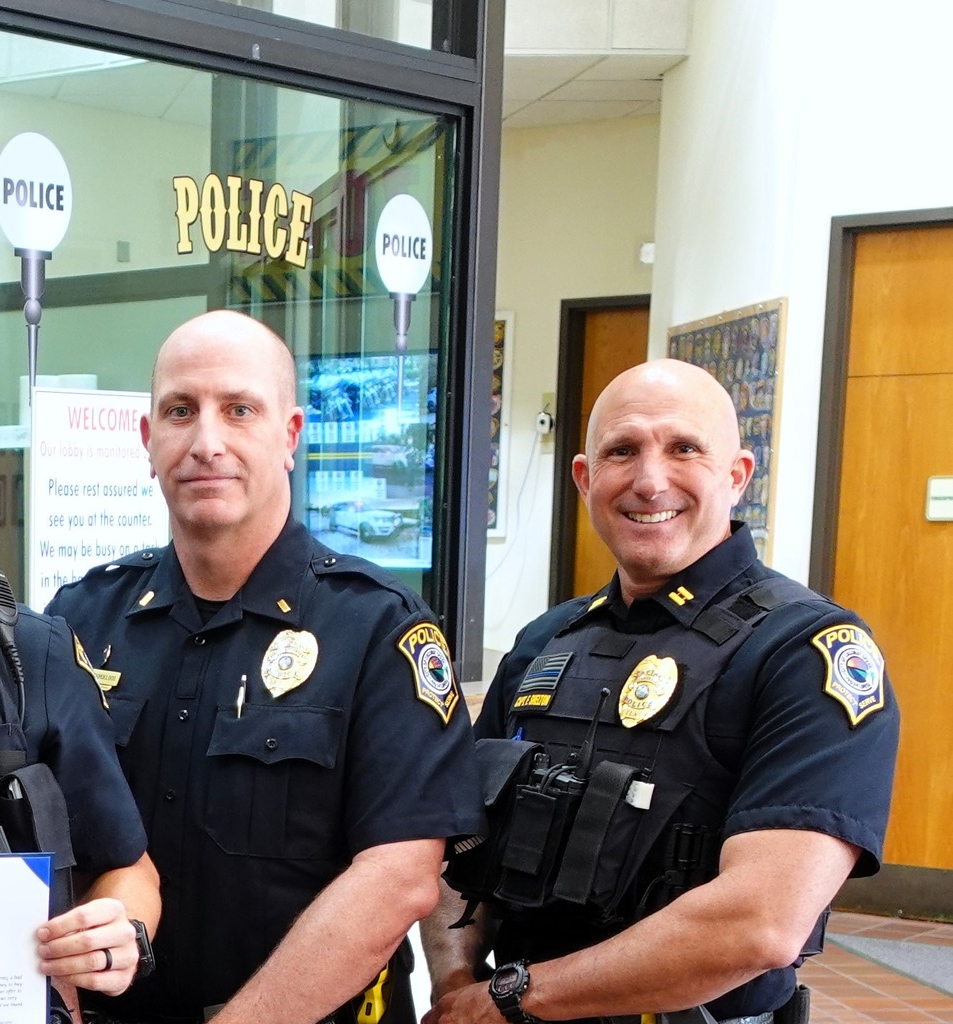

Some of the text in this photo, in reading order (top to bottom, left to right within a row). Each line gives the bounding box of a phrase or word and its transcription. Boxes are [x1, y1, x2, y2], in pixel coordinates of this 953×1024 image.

[3, 176, 65, 212] POLICE
[172, 172, 314, 270] POLICE
[381, 232, 427, 261] POLICE
[68, 405, 138, 432] WELCOME
[40, 440, 56, 457] Our
[60, 440, 84, 459] lobby
[87, 445, 94, 458] is
[96, 444, 141, 459] monitored
[48, 478, 154, 497] Please rest assured we
[48, 509, 153, 532] see you at the counter.
[40, 540, 56, 558] We
[58, 546, 78, 562] may
[81, 538, 93, 558] be
[96, 538, 116, 562] busy
[119, 546, 131, 556] on
[40, 571, 50, 588] in
[408, 628, 448, 655] POLICE
[832, 682, 858, 706] PROTECT
